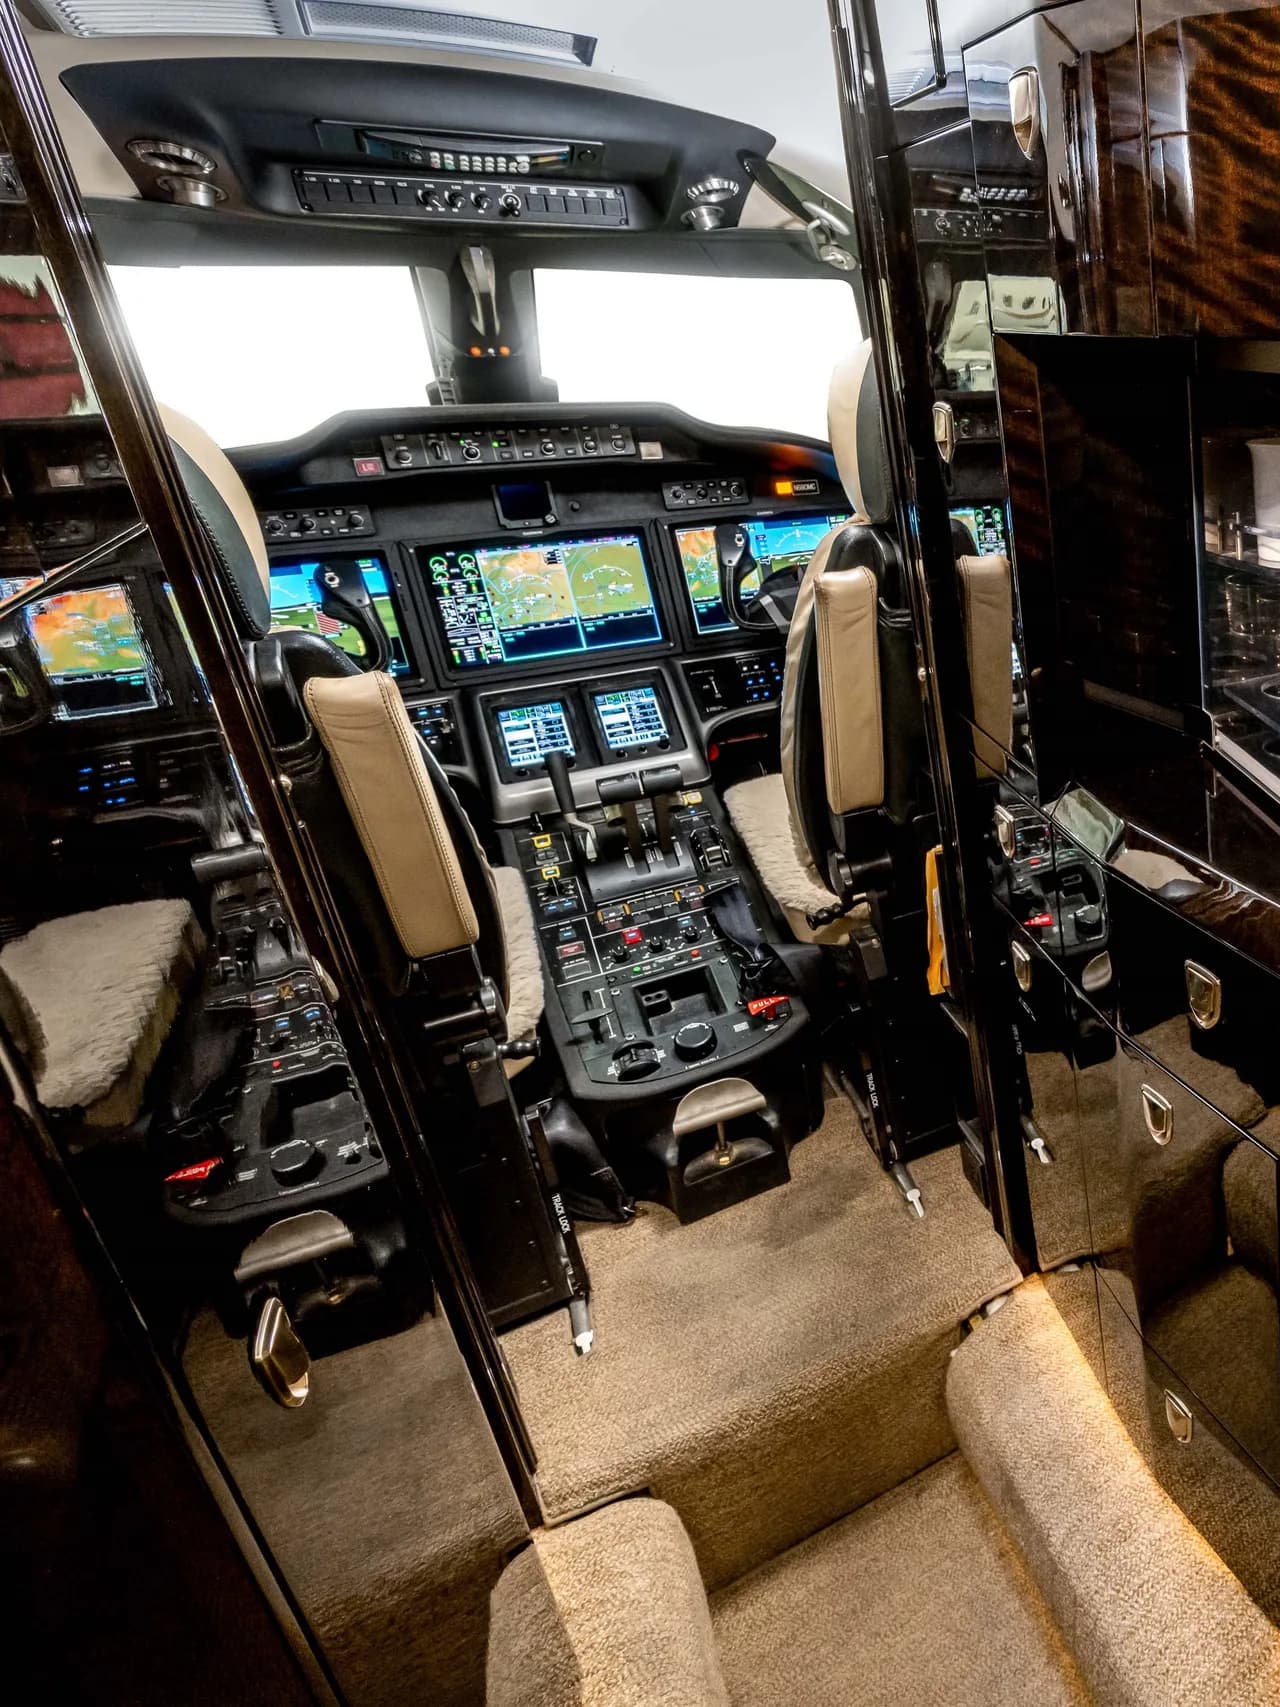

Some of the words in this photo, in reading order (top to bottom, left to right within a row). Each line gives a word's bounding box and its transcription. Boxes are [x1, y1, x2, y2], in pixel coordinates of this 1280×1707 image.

[752, 998, 775, 1009] PULL
[866, 1072, 876, 1092] TRACK
[870, 1092, 879, 1109] LOCK
[551, 1193, 565, 1216] TRACK
[558, 1215, 571, 1234] LOCK
